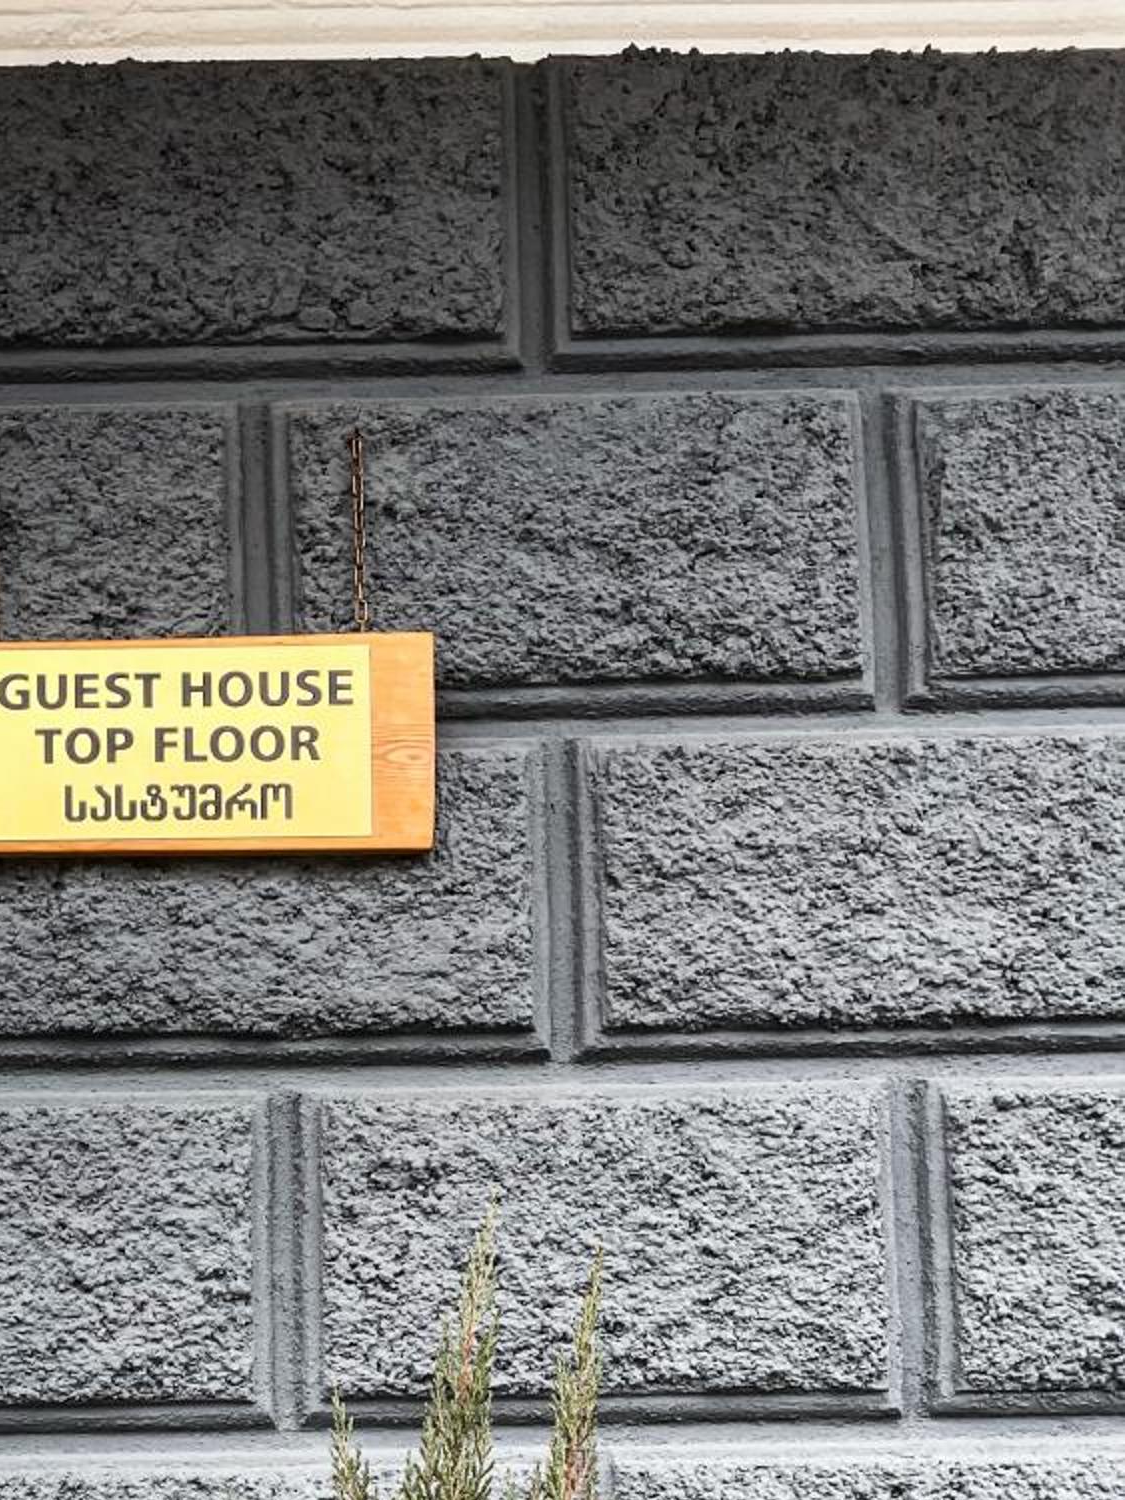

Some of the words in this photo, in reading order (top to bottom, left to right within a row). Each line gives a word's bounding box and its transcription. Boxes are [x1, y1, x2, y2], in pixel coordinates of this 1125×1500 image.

[181, 669, 354, 708] HOUSE
[35, 727, 134, 765] TOP
[154, 725, 321, 763] FLOOR
[64, 783, 293, 822] სასტუმრო
